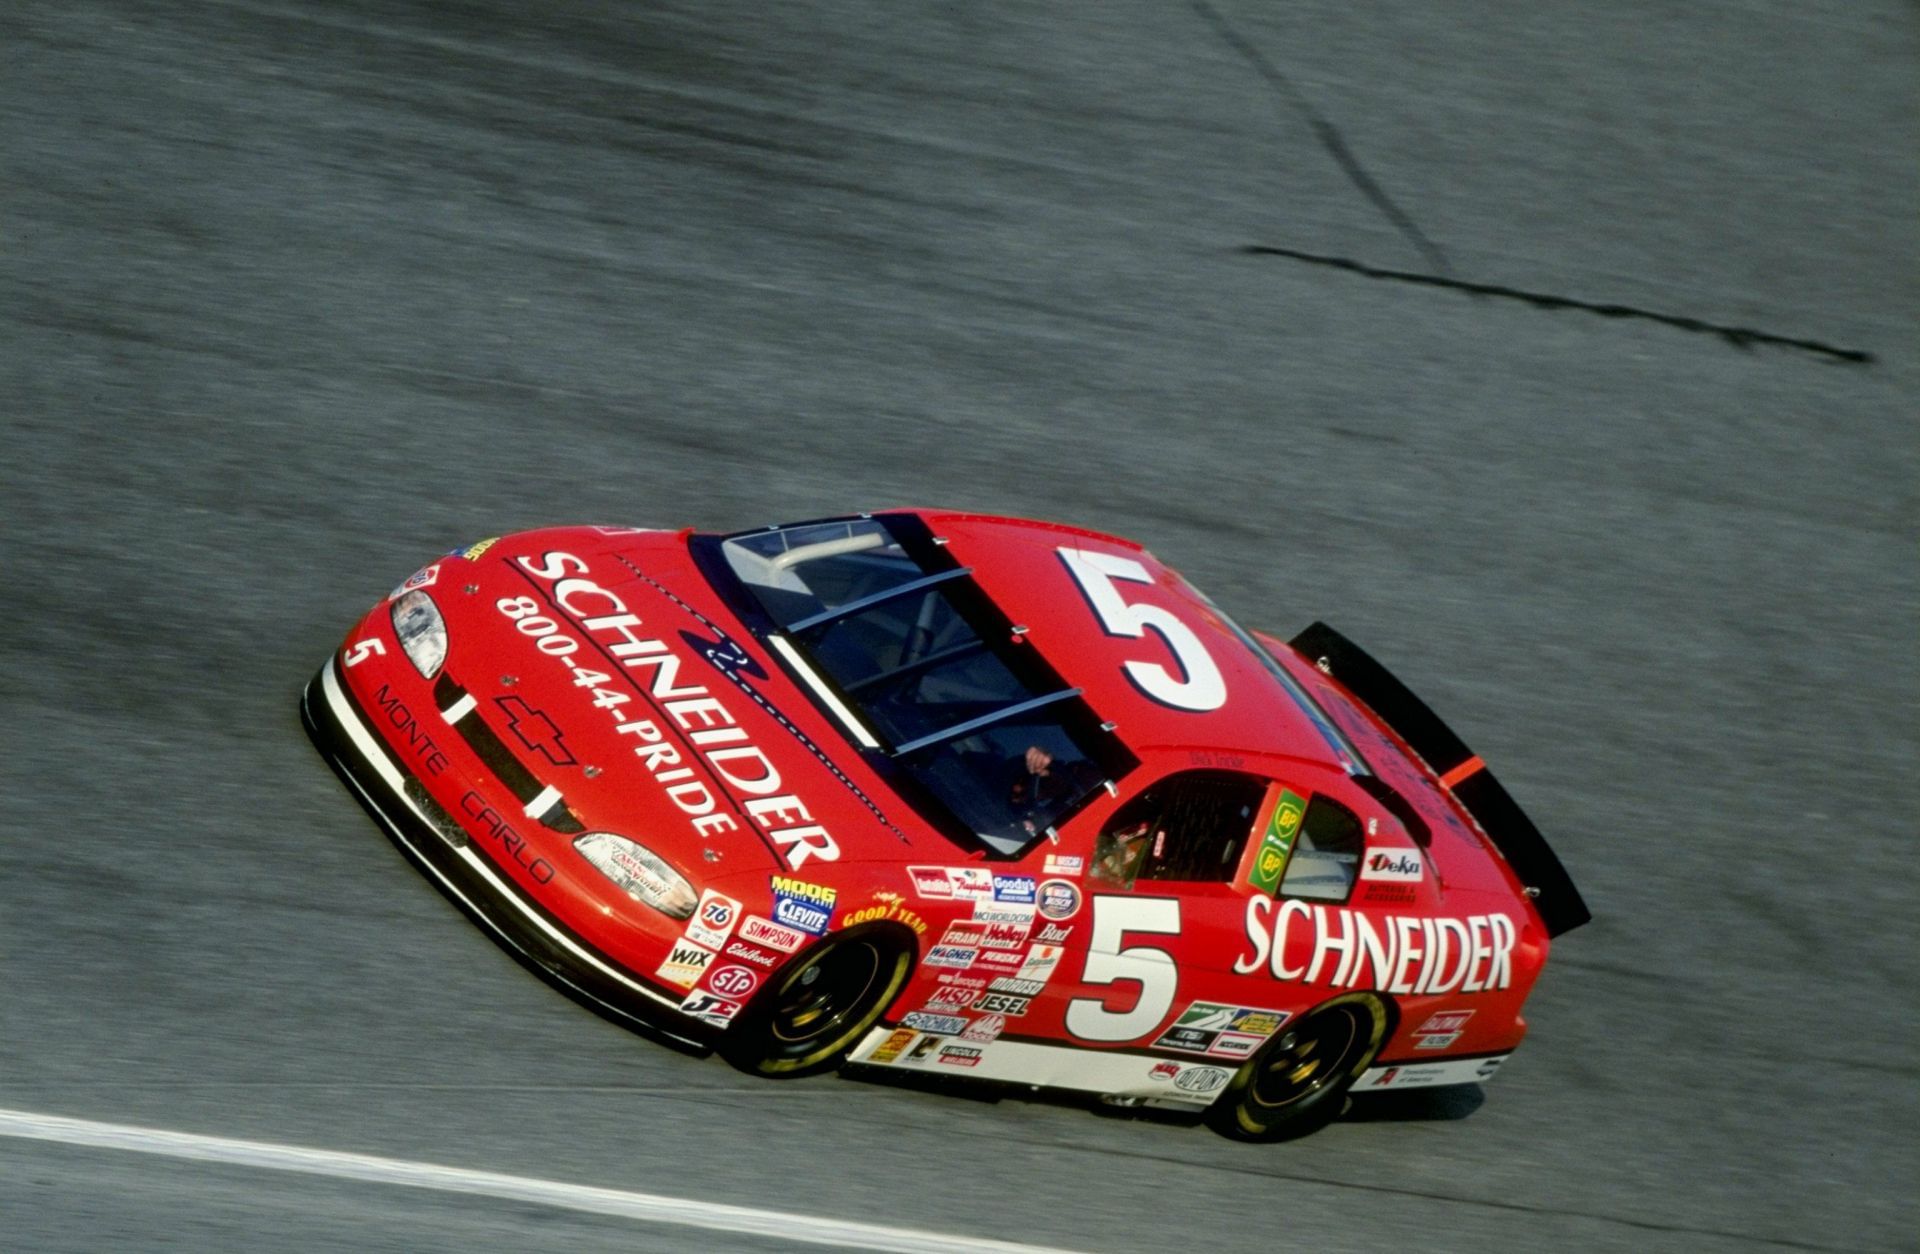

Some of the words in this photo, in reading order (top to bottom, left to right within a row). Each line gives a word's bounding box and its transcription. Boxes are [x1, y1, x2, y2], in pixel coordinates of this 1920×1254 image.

[1056, 546, 1227, 713] 5
[344, 638, 388, 668] 5
[496, 596, 738, 838] 800-44-PRIDE
[516, 551, 841, 871] SCHNEIDER
[374, 684, 448, 777] MONTE
[460, 790, 555, 885] CARLO
[1279, 809, 1297, 828] BP
[1263, 853, 1281, 872] BP
[1370, 853, 1420, 875] Deka
[772, 876, 837, 901] MOOG
[994, 876, 1036, 892] Goody's
[703, 902, 731, 924] 76
[746, 921, 800, 949] SIMPSON
[943, 931, 980, 945] FRAM
[987, 923, 1025, 945] Holley
[1037, 922, 1074, 941] Bud
[930, 946, 976, 961] WAGNER
[1233, 894, 1516, 994] SCHNEIDER
[670, 948, 712, 967] WIX
[1064, 894, 1181, 1042] 5
[714, 969, 751, 993] STP
[931, 986, 976, 1005] MSD
[972, 994, 1030, 1015] JESEL
